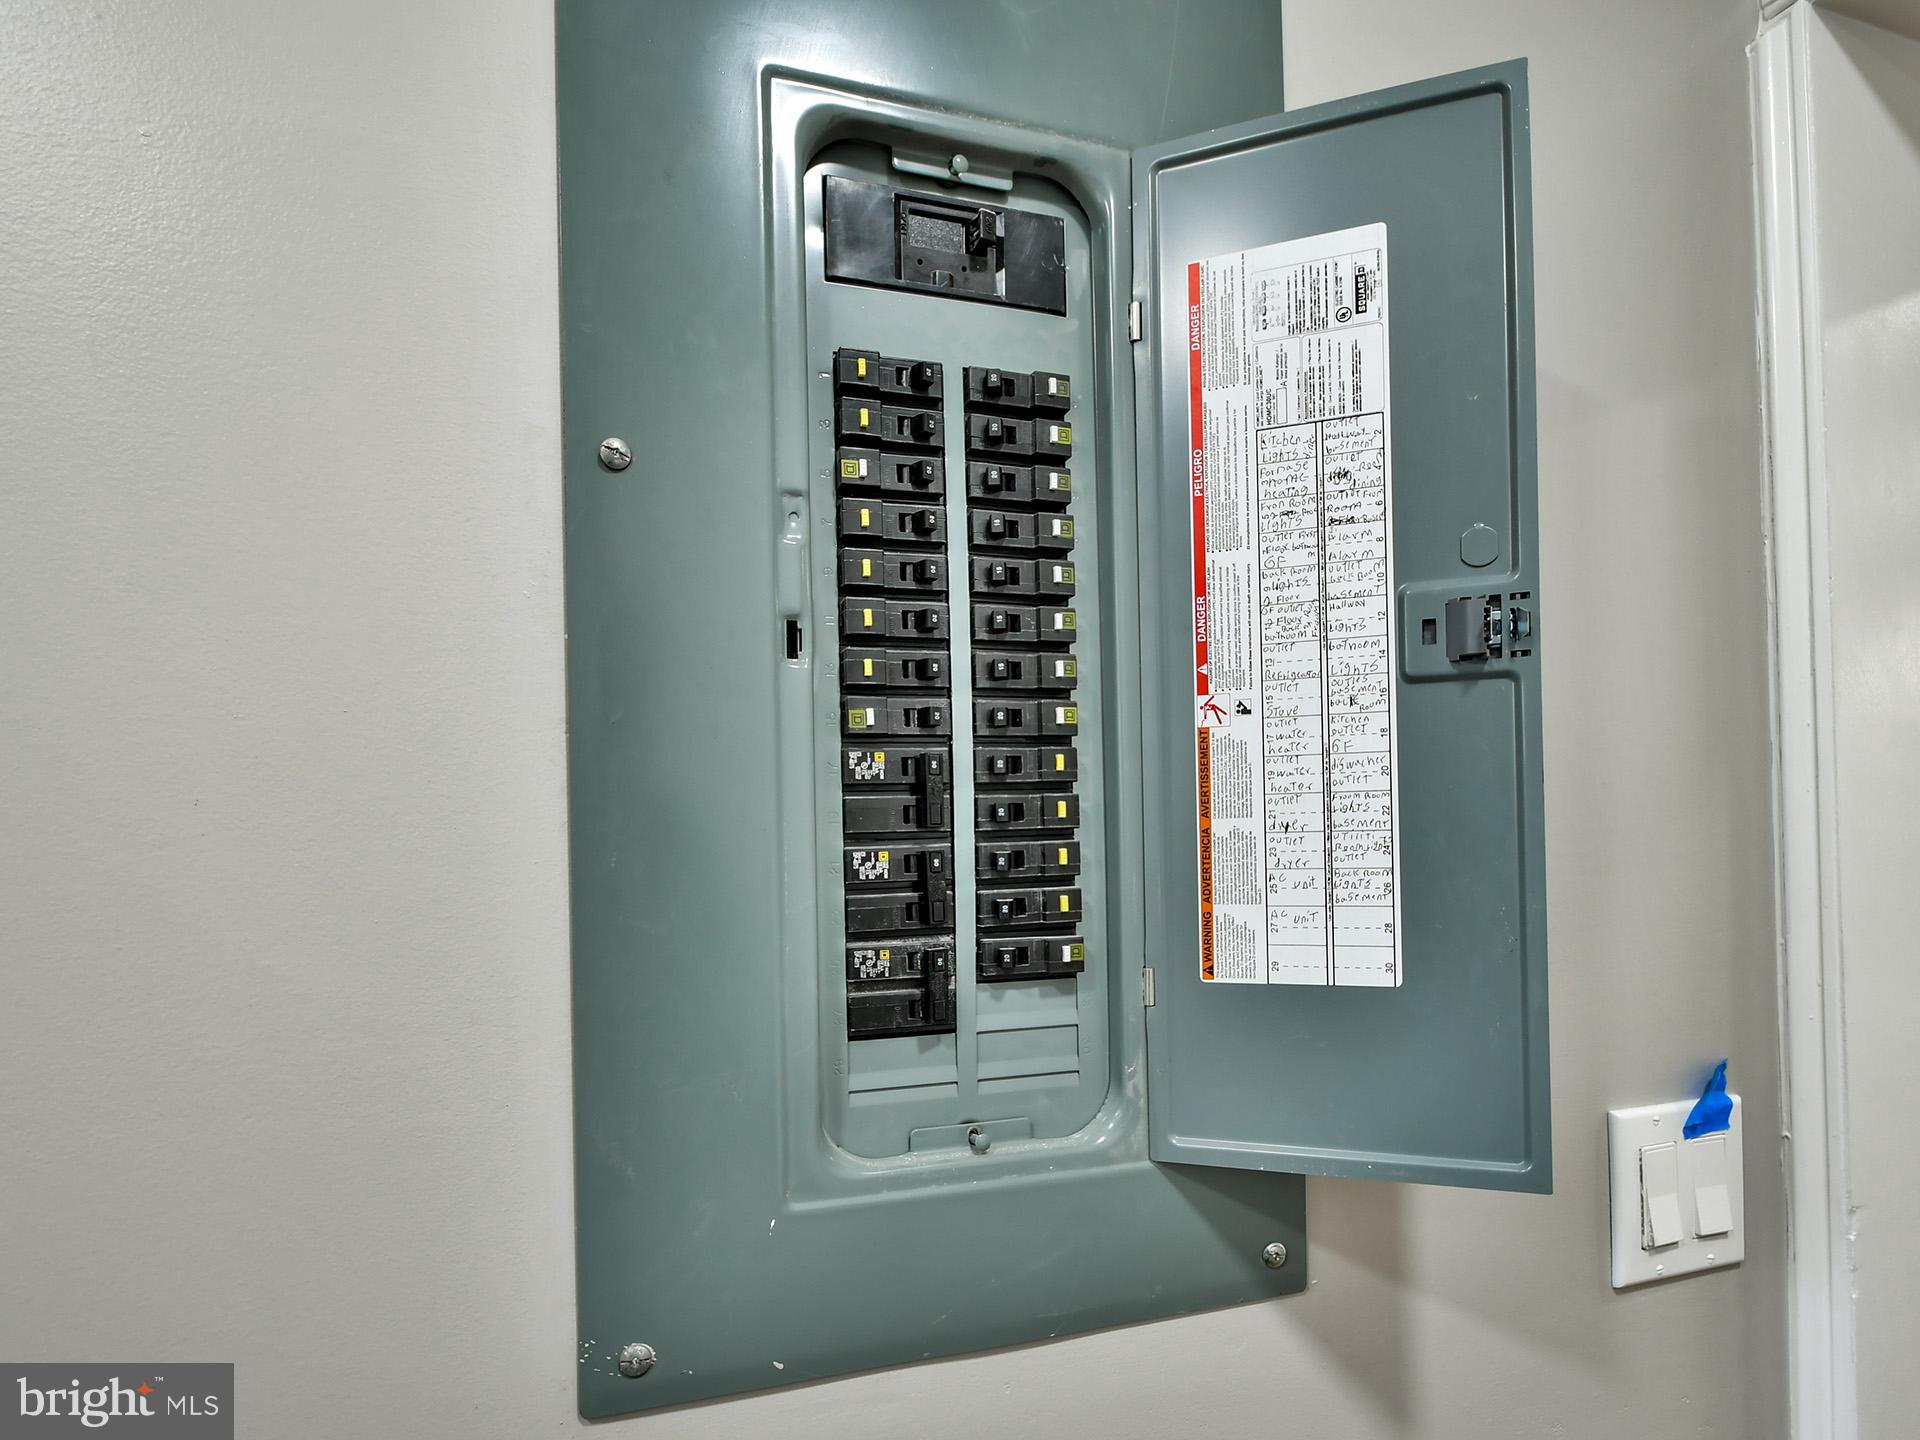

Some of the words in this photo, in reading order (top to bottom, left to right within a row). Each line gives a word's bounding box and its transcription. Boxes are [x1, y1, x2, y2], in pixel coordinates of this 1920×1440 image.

[1357, 265, 1364, 274] D
[1357, 275, 1365, 312] SQUARE
[1190, 303, 1199, 350] DANGER
[926, 367, 932, 377] 20
[990, 373, 998, 382] 20
[928, 419, 935, 429] 20
[991, 423, 998, 431] 20
[926, 465, 932, 475] 20
[990, 470, 998, 479] 20
[1193, 448, 1202, 496] PELIGRO
[929, 515, 935, 524] 20
[993, 518, 1001, 527] 15
[930, 565, 937, 574] 20
[995, 566, 1003, 574] 15
[1376, 571, 1385, 582] 10
[931, 613, 938, 623] 20
[996, 614, 1003, 623] 15
[1196, 595, 1206, 642] DANGER
[1377, 610, 1386, 621] 12
[1378, 649, 1386, 659] 14
[932, 663, 939, 672] 20
[997, 662, 1005, 671] 15
[1265, 658, 1273, 668] 13
[1379, 687, 1387, 697] 16
[1266, 695, 1274, 705] 15
[934, 711, 941, 720] 20
[996, 711, 1004, 720] 20
[1380, 727, 1388, 737] 18
[1266, 733, 1274, 744] 17
[931, 760, 938, 769] 30
[996, 759, 1004, 768] 20
[1199, 729, 1209, 818] AVERTISSEMENT
[1267, 770, 1275, 781] 19
[1380, 765, 1389, 776] 20
[997, 807, 1005, 817] 20
[1268, 809, 1277, 819] 21
[1381, 805, 1390, 815] 22
[1269, 847, 1278, 858] 23
[998, 857, 1005, 866] 20
[1201, 827, 1211, 903] ADVERTENCIA
[1269, 883, 1278, 894] 25
[1383, 882, 1392, 894] 26
[1002, 904, 1009, 913] 20
[1270, 922, 1279, 933] 27
[1384, 922, 1393, 934] 28
[1202, 911, 1212, 962] WARNING
[937, 957, 943, 966] 30
[1003, 954, 1011, 963] 20
[1271, 961, 1280, 972] 29
[1385, 962, 1394, 974] 30
